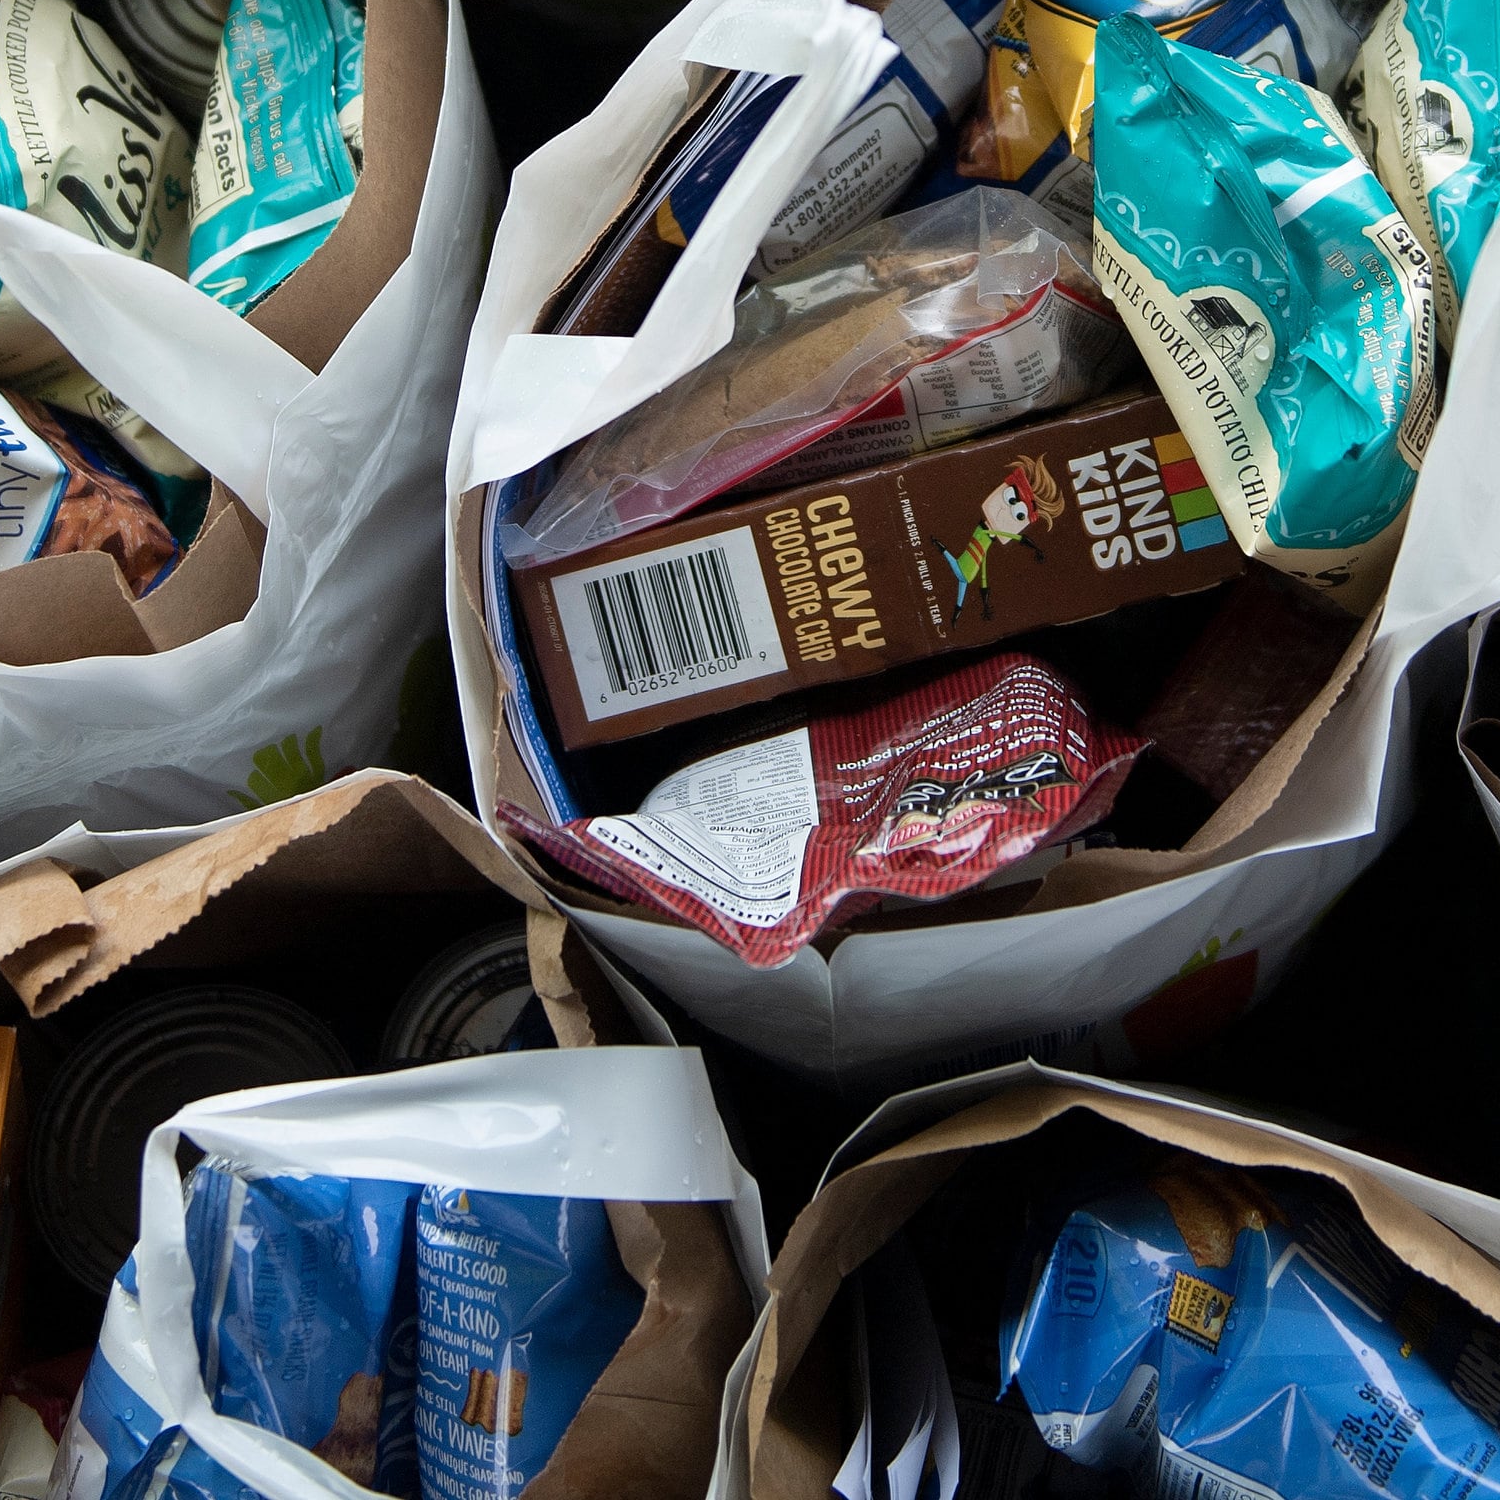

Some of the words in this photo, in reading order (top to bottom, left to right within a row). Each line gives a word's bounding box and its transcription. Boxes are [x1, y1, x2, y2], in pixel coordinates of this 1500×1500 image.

[248, 19, 268, 44] our
[4, 32, 30, 95] COOKED
[226, 11, 261, 124] 1-877-9-Vickie
[254, 48, 282, 92] chips?
[266, 94, 285, 119] Give
[12, 96, 54, 166] KETTLE
[268, 119, 282, 139] us
[212, 129, 241, 193] Facts
[271, 142, 283, 150] a
[818, 177, 829, 190] or
[828, 129, 882, 180] Comments?
[273, 151, 294, 178] call!
[784, 147, 883, 236] 1-800-352-4477
[1391, 77, 1416, 160] COOKED
[1405, 162, 1435, 238] POTATO
[1432, 249, 1453, 313] CHIPS
[1325, 250, 1357, 278] call!
[1391, 227, 1434, 290] Facts
[1360, 327, 1386, 363] chips?
[1092, 237, 1143, 306] KETTLE
[1140, 299, 1209, 385] COOKED
[1196, 375, 1255, 462] POTATO
[1236, 463, 1271, 534] CHIPS
[1374, 366, 1389, 390] our
[847, 419, 911, 438] CONTAINS
[940, 411, 961, 421] 2,500
[898, 498, 917, 523] PINCH
[1109, 437, 1177, 561] KIND
[904, 523, 923, 548] SIDES
[915, 559, 931, 580] PULL
[919, 579, 934, 591] UP
[928, 604, 943, 625] TEAR
[600, 694, 608, 704] 6
[627, 672, 679, 696] 02652
[687, 655, 738, 680] 20600
[759, 651, 767, 662] 9
[988, 719, 1003, 730] &
[1007, 712, 1060, 726] HEAT
[976, 749, 1003, 764] OR
[1007, 732, 1058, 753] TEAR
[836, 748, 892, 773] portion
[929, 755, 971, 771] CUT
[842, 774, 885, 794] serve
[767, 806, 810, 820] Calcium
[597, 826, 664, 871] Facts
[458, 1229, 499, 1259] BELIEVE
[456, 1254, 470, 1278] IS
[472, 1261, 508, 1288] GOOD.
[1063, 1239, 1099, 1306] 210
[1185, 1286, 1201, 1320] GRAIN
[1190, 1288, 1209, 1327] WHOLE
[427, 1323, 470, 1350] SNACKING
[472, 1337, 494, 1360] FROM
[419, 1339, 434, 1363] OH
[434, 1345, 470, 1376] YEAH!
[435, 1392, 458, 1417] STILL
[1357, 1382, 1383, 1402] 96
[448, 1418, 508, 1469] WAVES
[1332, 1414, 1365, 1459] 18:22
[1349, 1424, 1386, 1471] 04102
[434, 1466, 467, 1497] WHOLE
[438, 1450, 470, 1476] UNIQUE
[470, 1461, 498, 1486] SHAPE
[507, 1467, 524, 1484] AND
